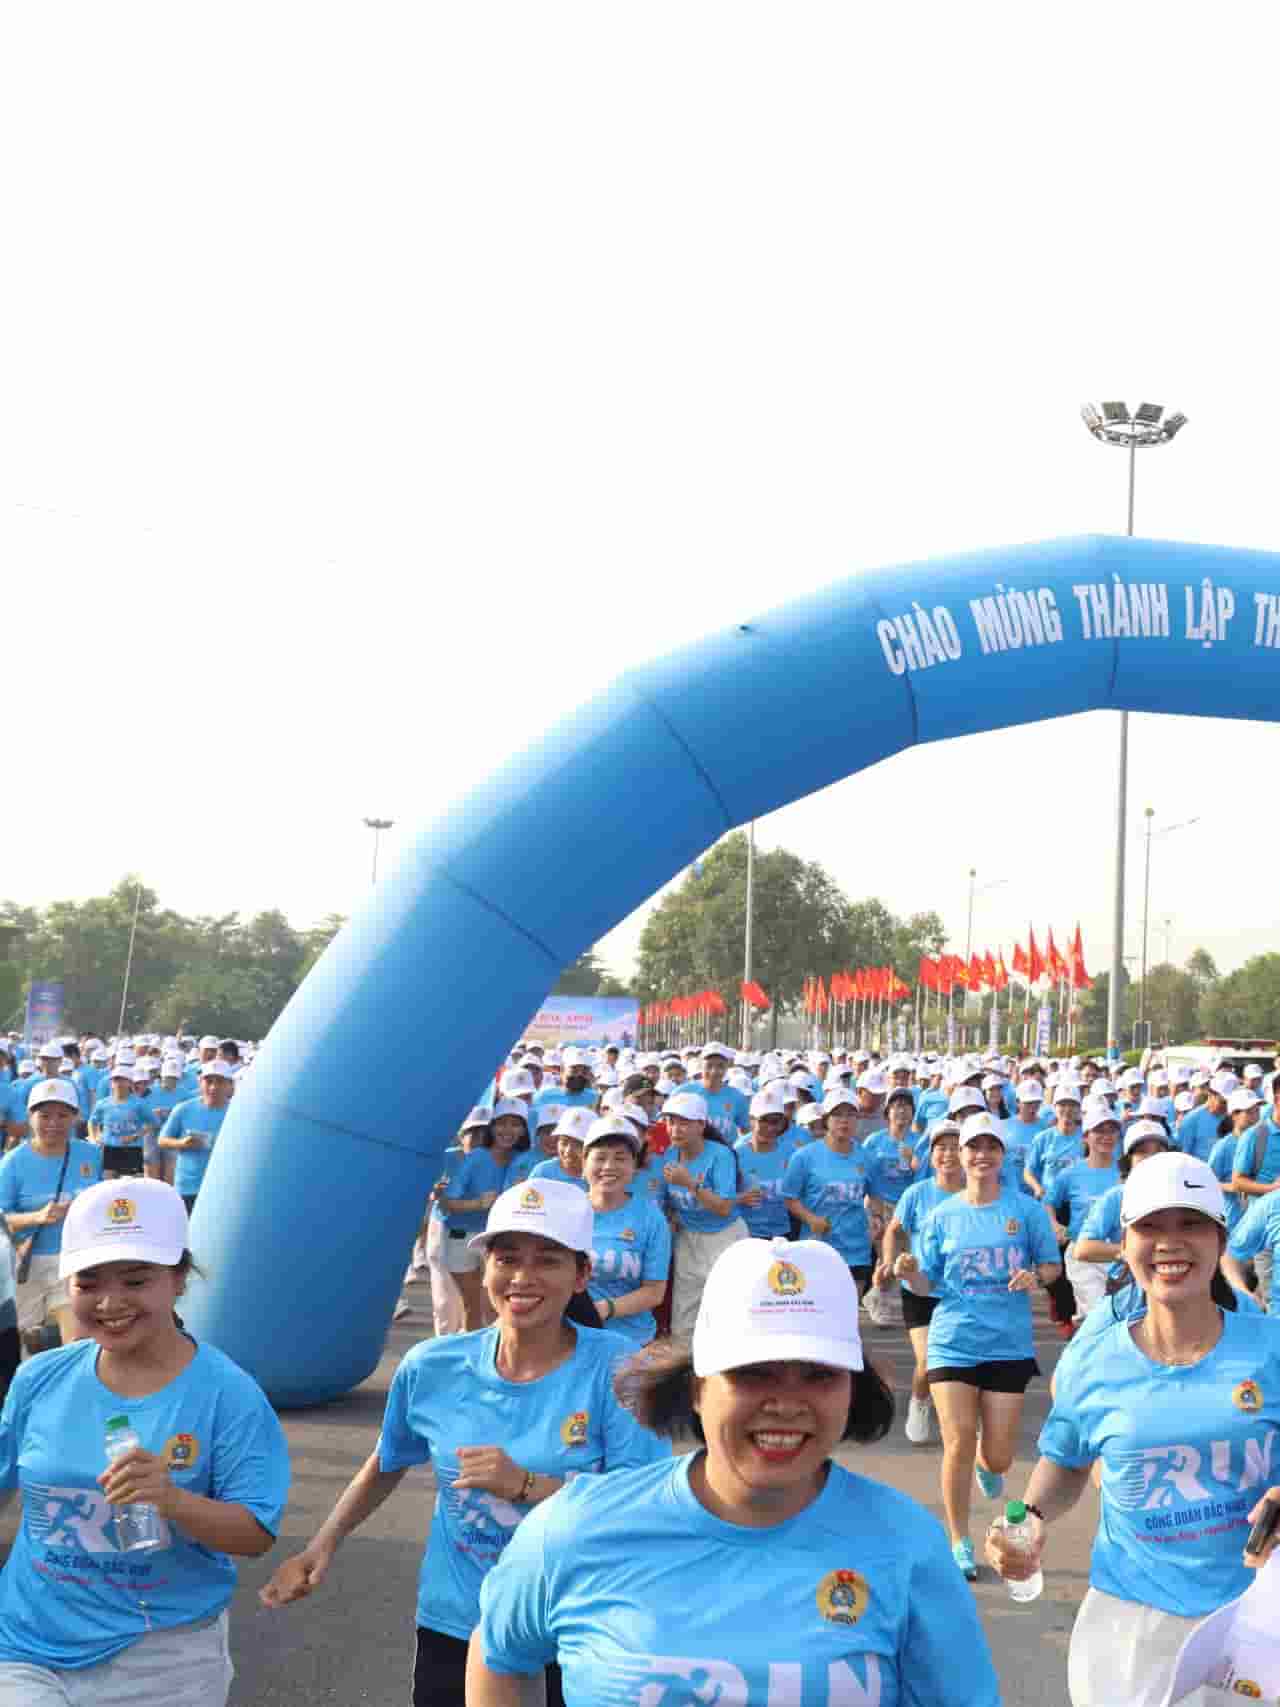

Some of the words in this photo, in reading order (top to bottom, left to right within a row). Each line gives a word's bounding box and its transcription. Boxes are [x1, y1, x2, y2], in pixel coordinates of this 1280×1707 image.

[876, 601, 961, 675] CHÀO
[969, 581, 1063, 655] MỪNG
[1072, 571, 1170, 640] THÀNH
[1184, 576, 1235, 648] LẬP
